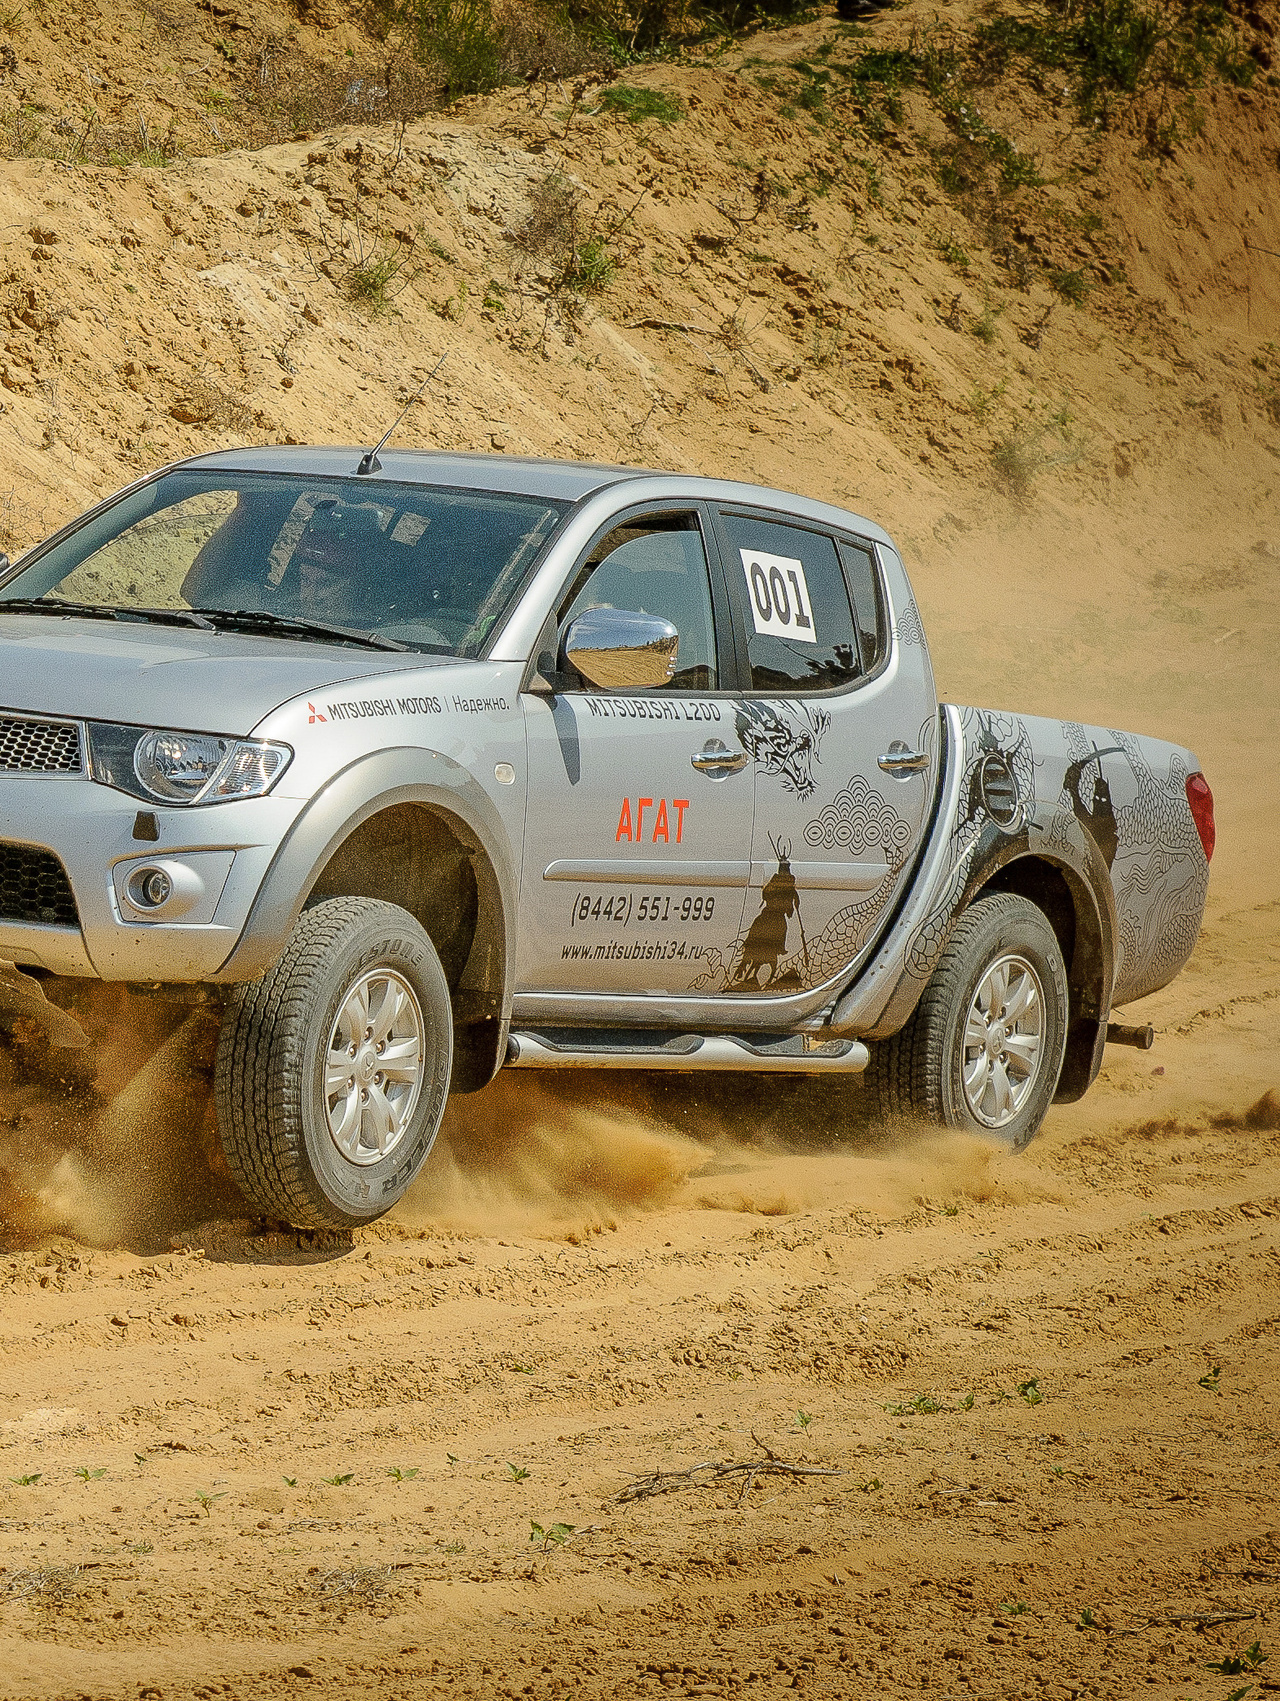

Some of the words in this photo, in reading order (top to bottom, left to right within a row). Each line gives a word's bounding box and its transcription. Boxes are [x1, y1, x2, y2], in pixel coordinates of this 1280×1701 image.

[750, 562, 811, 629] 001
[327, 699, 397, 721] MITSUBISHI
[396, 696, 442, 715] MOTORS
[452, 695, 510, 714] Надежно.
[584, 698, 680, 720] MITSUBISHI
[679, 701, 721, 721] L200
[615, 797, 690, 843] АГАТ
[572, 893, 632, 927] (8442)
[637, 896, 715, 921] 551-999
[561, 940, 703, 960] www.mitsubishi34.ru
